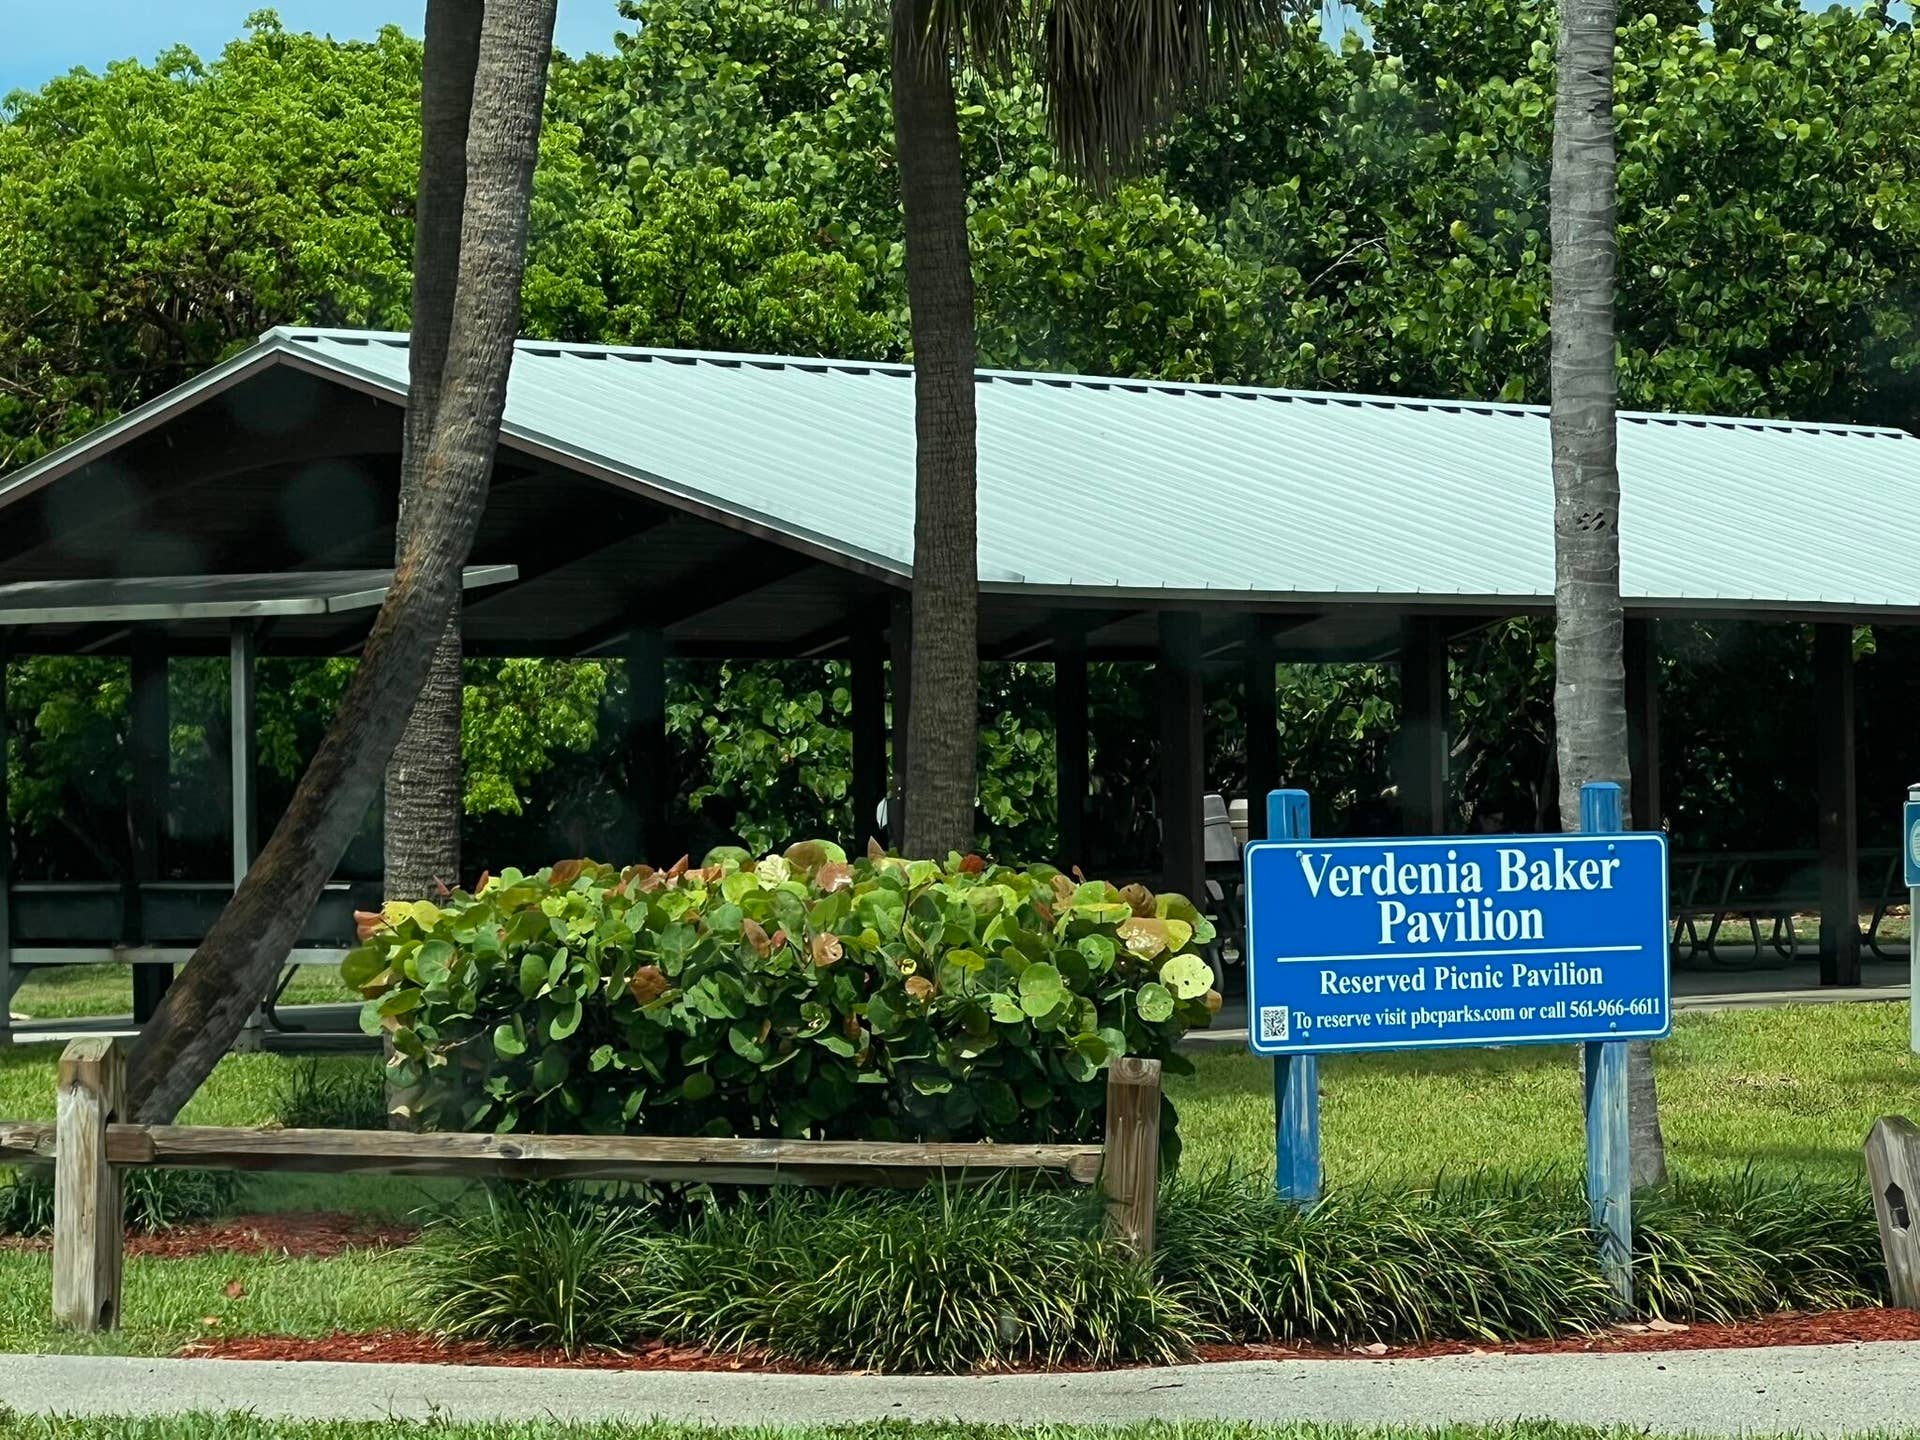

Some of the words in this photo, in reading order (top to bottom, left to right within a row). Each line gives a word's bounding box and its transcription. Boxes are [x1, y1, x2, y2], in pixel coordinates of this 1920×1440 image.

[1301, 849, 1483, 898] Verdenia
[1496, 847, 1620, 893] Baker
[1377, 898, 1545, 945] Pavilion
[1320, 967, 1426, 995] Reserved
[1434, 964, 1504, 990] Picnic
[1511, 962, 1604, 988] Pavilion
[1292, 1011, 1312, 1029] To
[1316, 1012, 1371, 1028] reserve
[1375, 1009, 1407, 1026] visit
[1410, 1005, 1515, 1028] pbcparks.com
[1519, 1007, 1535, 1021] or
[1539, 1001, 1566, 1020] call
[1570, 998, 1660, 1018] 561-966-6611
